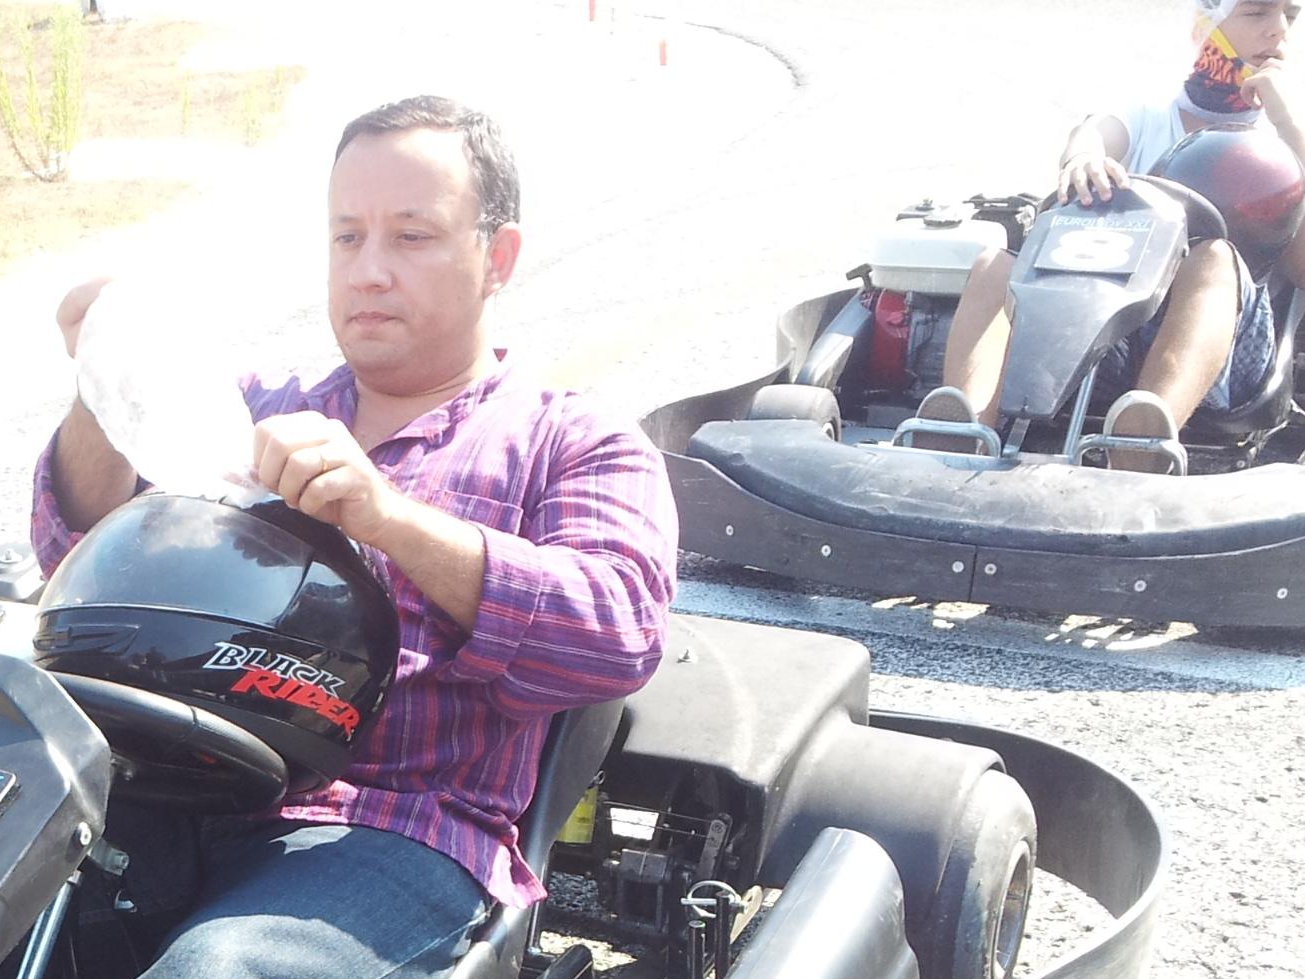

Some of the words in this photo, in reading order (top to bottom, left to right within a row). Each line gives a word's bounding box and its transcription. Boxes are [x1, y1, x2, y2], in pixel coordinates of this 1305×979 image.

[1051, 230, 1134, 270] 8
[202, 641, 346, 699] BLACK
[230, 669, 360, 736] RIDER
